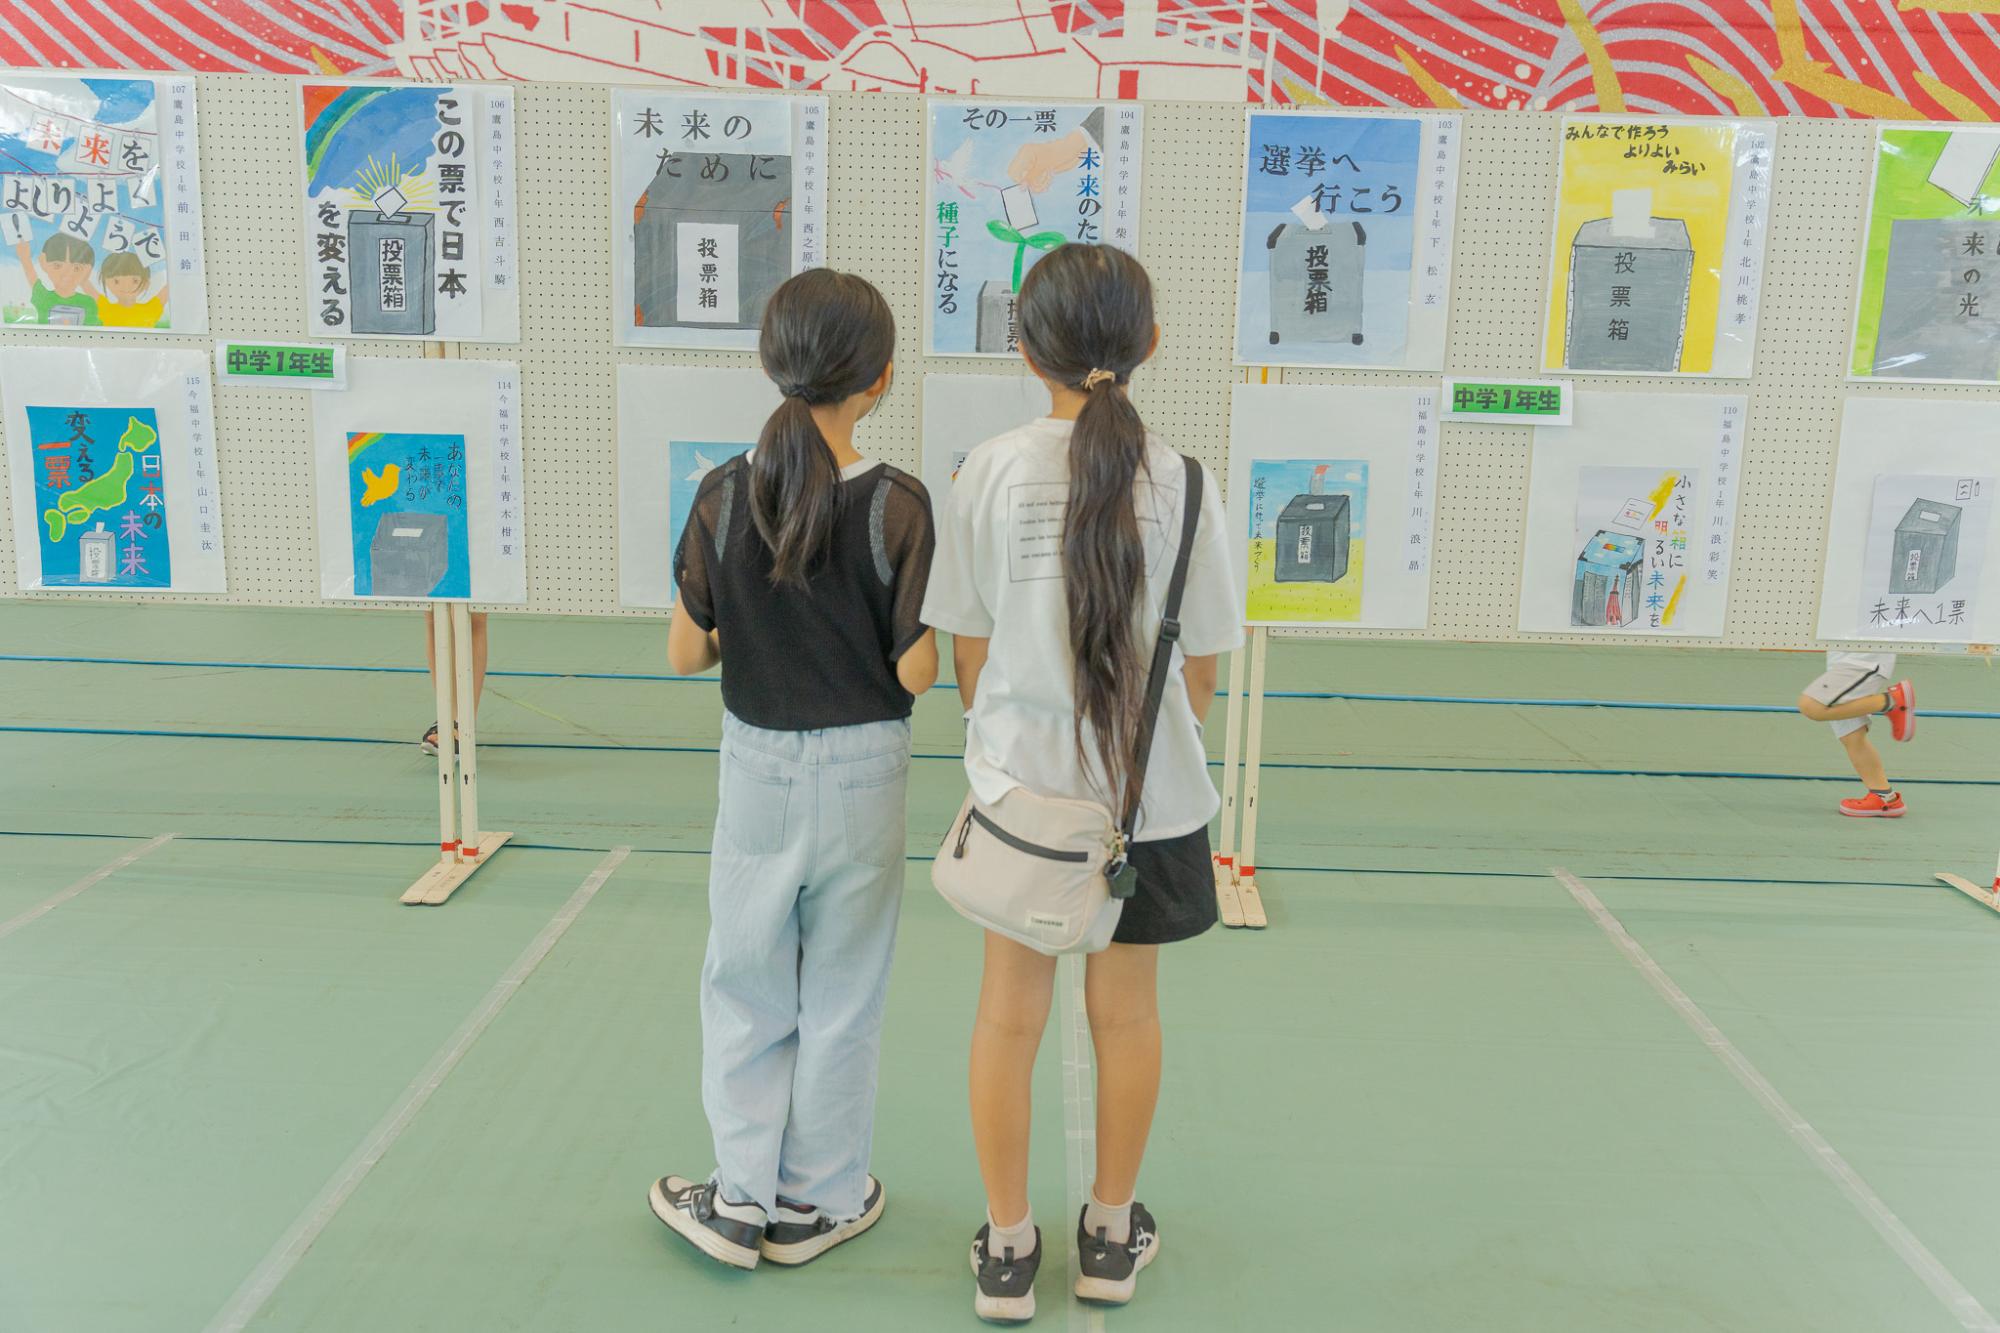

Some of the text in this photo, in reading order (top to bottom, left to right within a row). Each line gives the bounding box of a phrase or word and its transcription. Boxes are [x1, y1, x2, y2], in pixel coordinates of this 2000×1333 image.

[172, 85, 186, 94] 107
[491, 100, 505, 109] 106
[633, 107, 752, 141] 未来の
[804, 106, 819, 114] 105
[962, 107, 1057, 134] その一票
[1120, 111, 1134, 119] 104
[1437, 120, 1453, 129] 103
[32, 118, 149, 172] 未来を
[1565, 125, 1669, 142] みんなで作ろう
[1623, 143, 1680, 159] よりよい
[656, 147, 777, 183] ために
[1259, 143, 1361, 177] 選挙へ
[1662, 160, 1706, 176] みらい
[437, 98, 468, 299] この票で日本
[1076, 147, 1102, 245] 未来のた
[1312, 182, 1402, 214] 行こう
[936, 201, 960, 314] 種子になる
[1115, 227, 1127, 253] 柴
[1959, 197, 1988, 317] 未来の光
[316, 200, 348, 326] を変える
[381, 239, 404, 309] 投票箱
[697, 237, 720, 309] 投票箱
[1303, 244, 1333, 315] 投票箱
[1607, 251, 1637, 341] 投票箱
[228, 348, 334, 374] 中学1年生
[186, 376, 200, 385] 115
[497, 381, 511, 390] 114
[1454, 386, 1560, 411] 中学1年生
[1723, 406, 1738, 415] 110
[64, 410, 95, 483] 変える
[498, 394, 510, 484] 今福中学校1年
[1413, 411, 1428, 500] 福島中学校1年
[37, 441, 72, 489] 一票
[138, 454, 164, 530] 日本の
[1669, 475, 1691, 569] 小さな箱に
[119, 509, 150, 576] 未来
[1645, 520, 1669, 628] 明るい未来を
[1869, 597, 1967, 630] 未来へ1票
